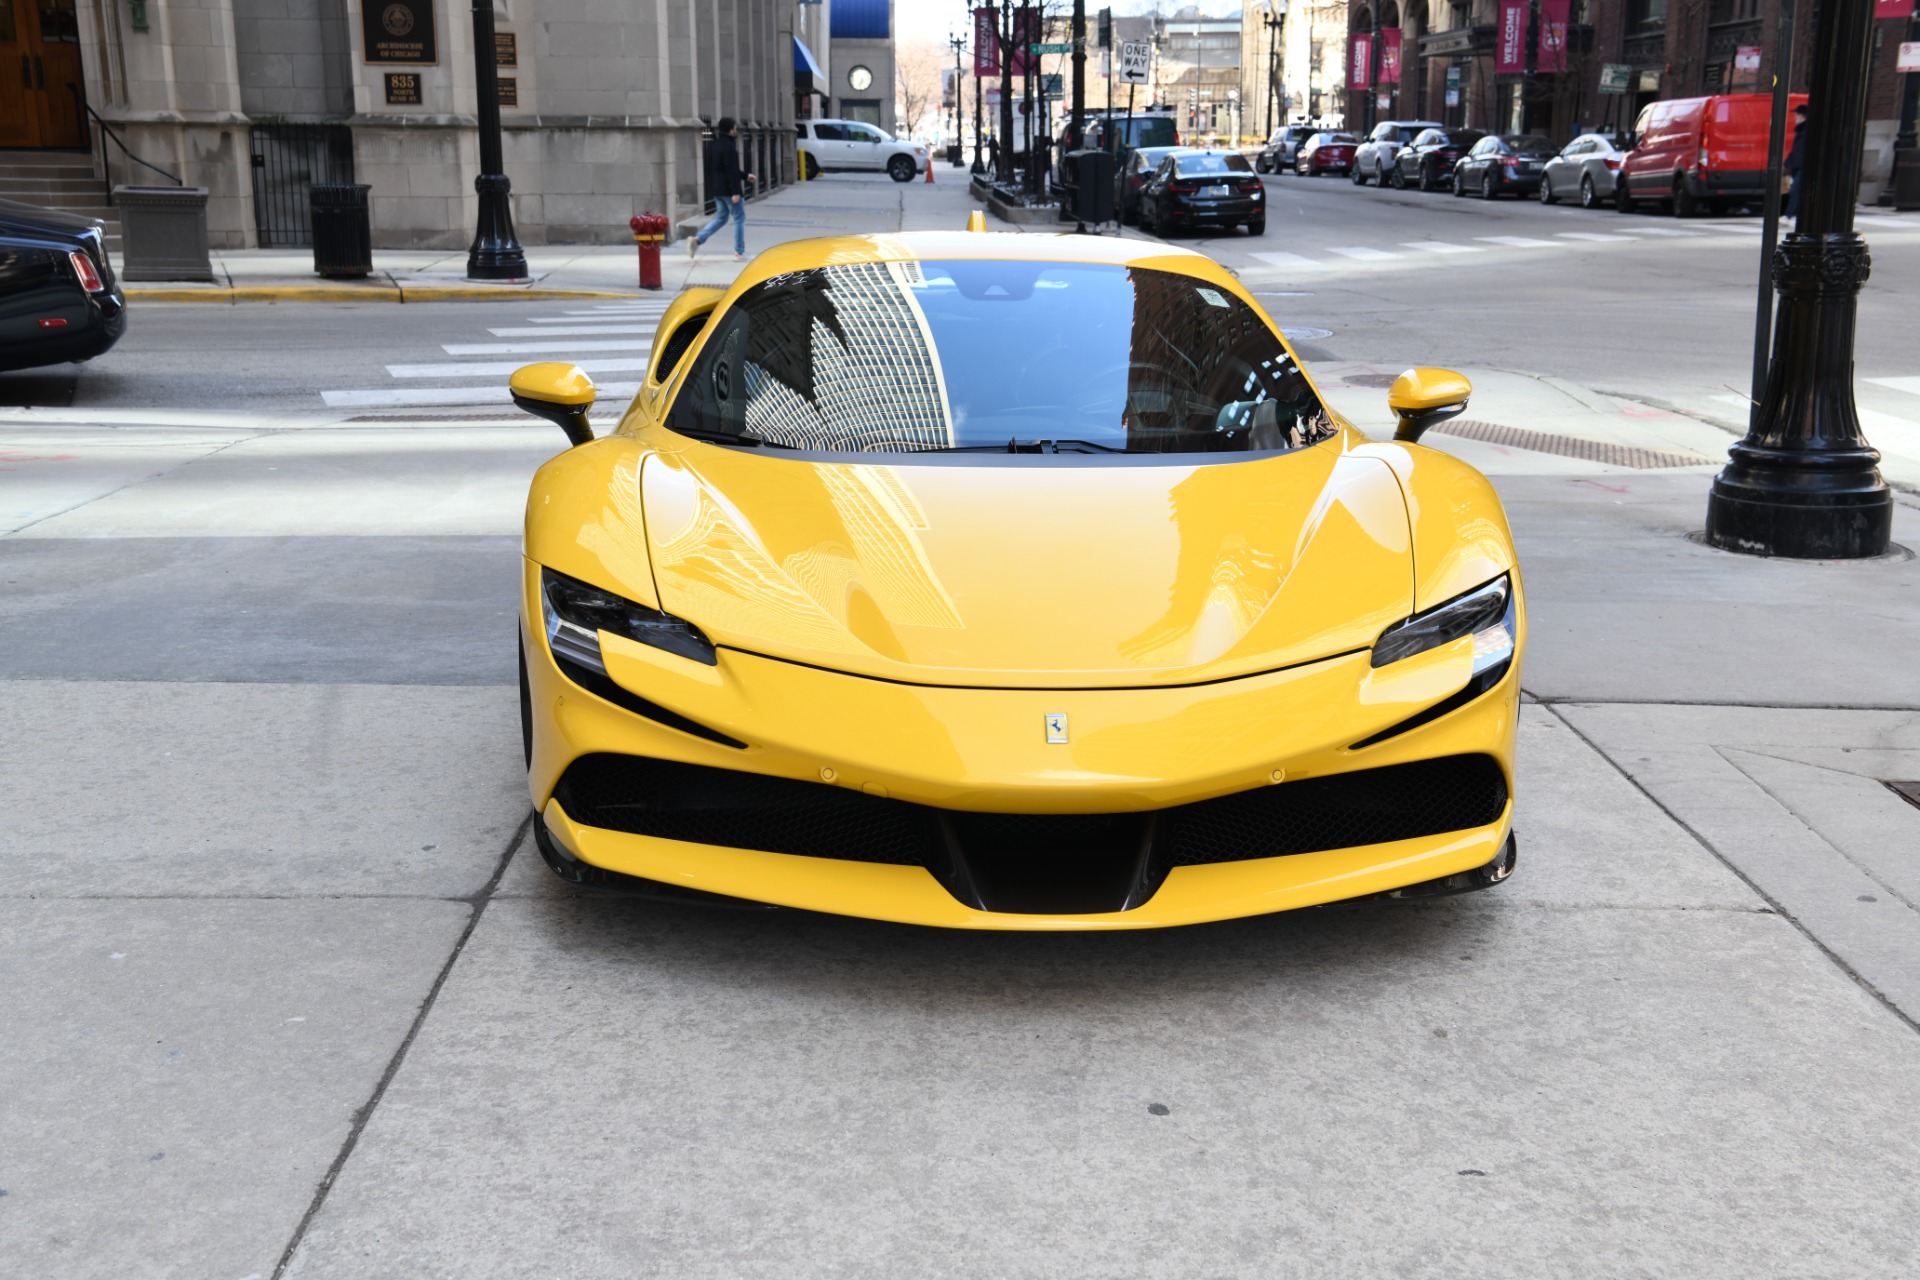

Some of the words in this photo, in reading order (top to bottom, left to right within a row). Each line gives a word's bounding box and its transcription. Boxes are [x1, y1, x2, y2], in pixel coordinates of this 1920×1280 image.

[1503, 7, 1515, 64] WELCOME
[1038, 45, 1060, 54] RUSH
[1125, 45, 1147, 56] ONE
[1124, 57, 1147, 67] WAY
[391, 75, 414, 88] 835
